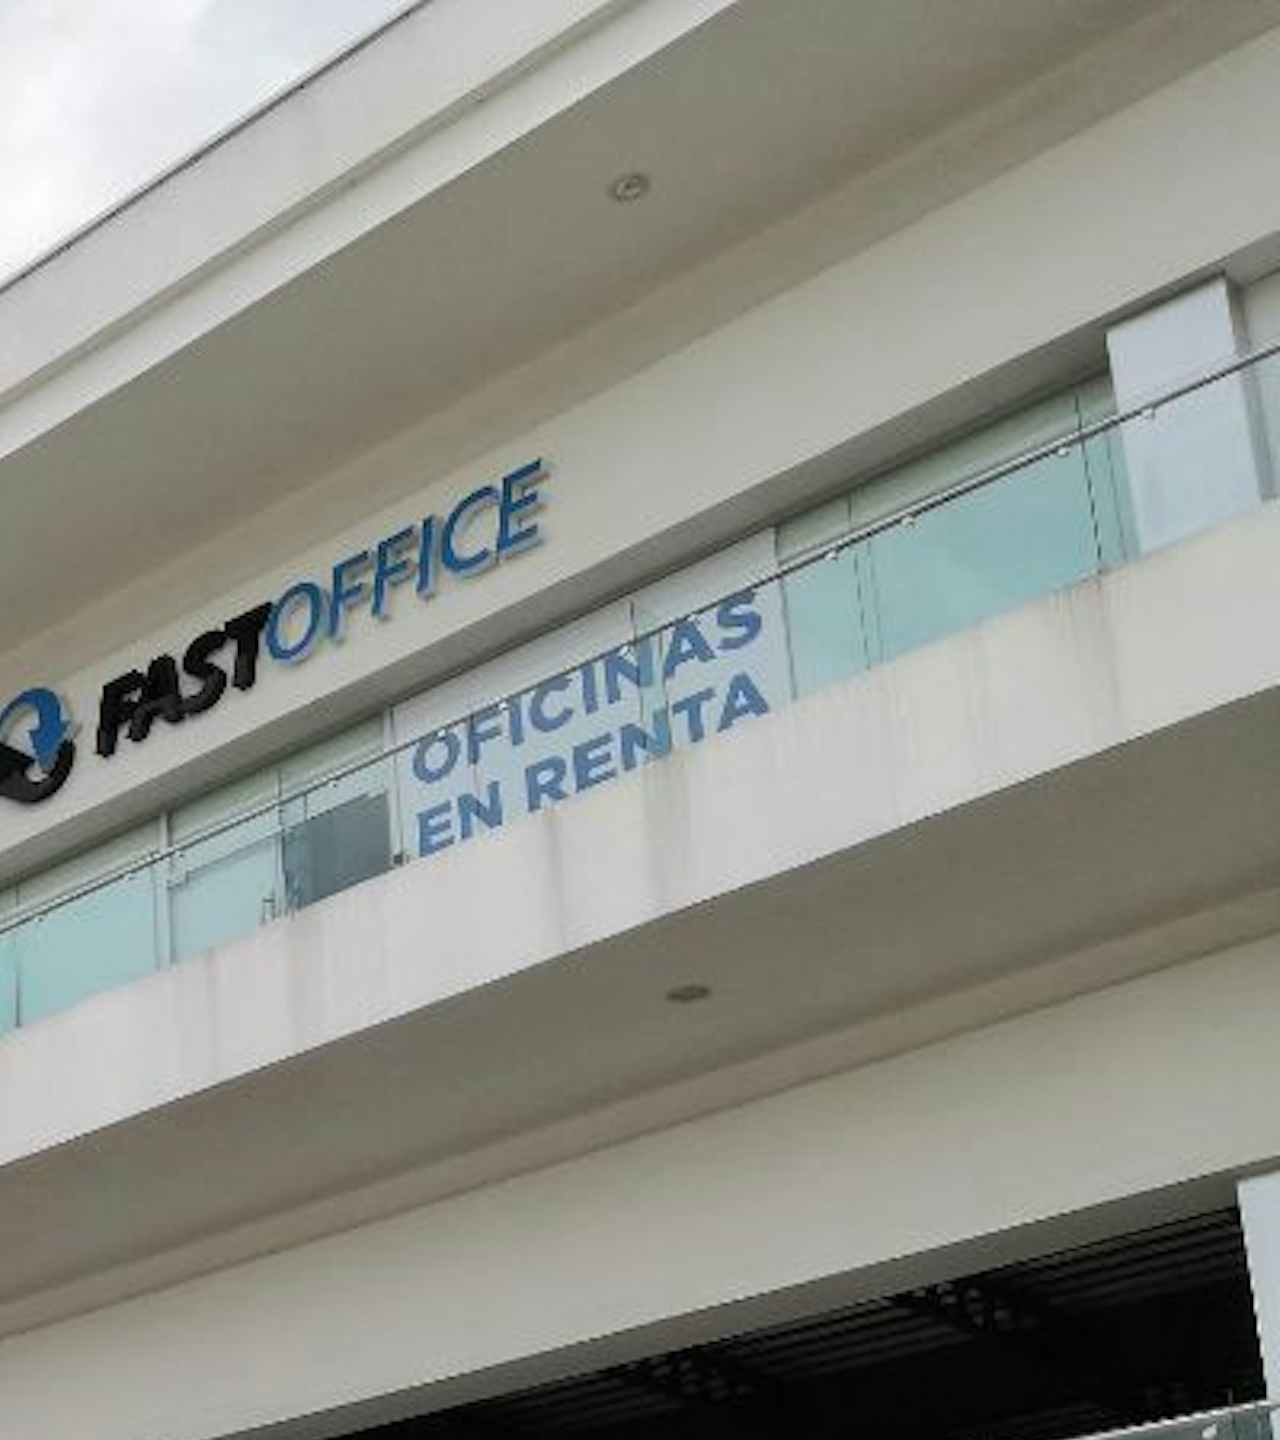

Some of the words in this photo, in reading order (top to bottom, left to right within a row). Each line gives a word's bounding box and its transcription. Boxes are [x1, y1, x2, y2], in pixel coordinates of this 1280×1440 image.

[412, 587, 763, 785] OFICINAS
[416, 779, 504, 858] EN
[524, 670, 771, 813] RENTA
